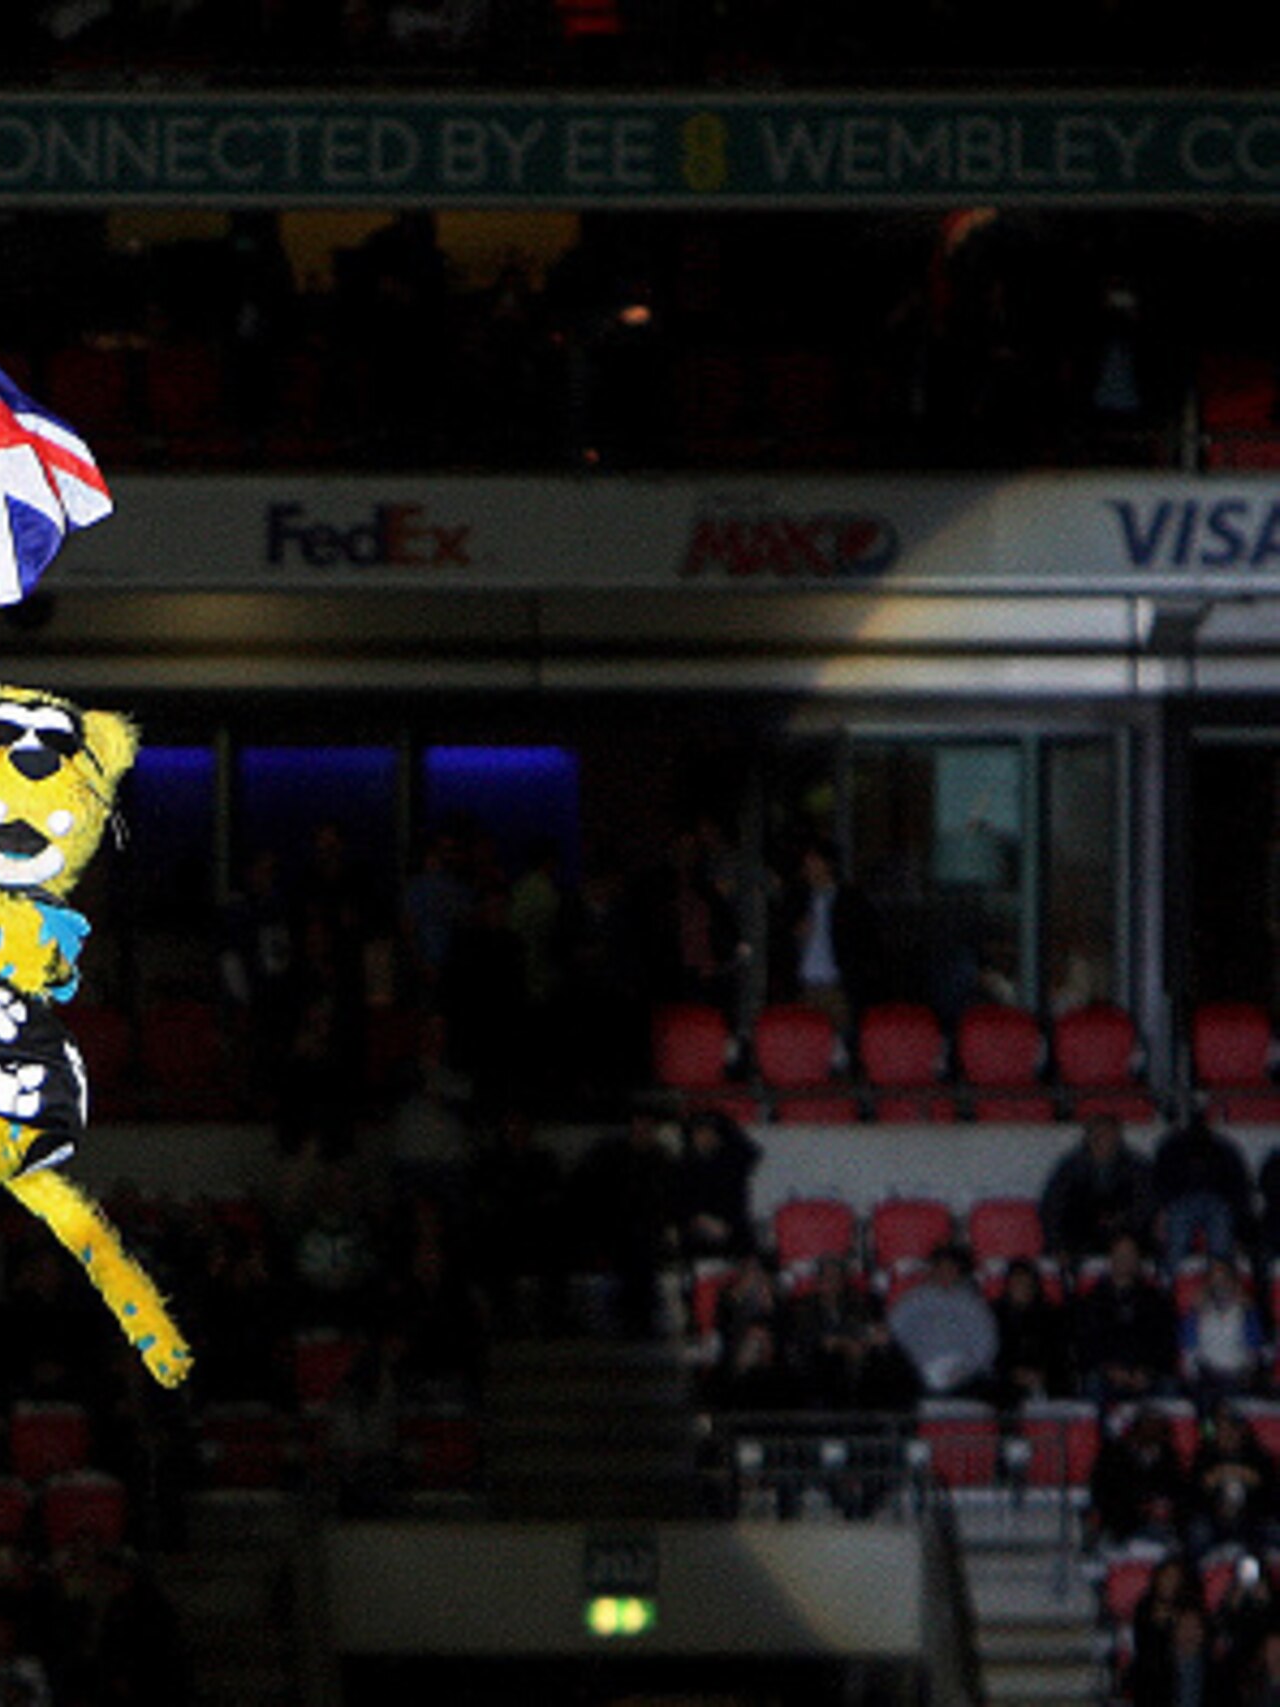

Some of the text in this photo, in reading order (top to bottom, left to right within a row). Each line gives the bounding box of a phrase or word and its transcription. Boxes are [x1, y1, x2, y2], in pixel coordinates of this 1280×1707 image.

[440, 116, 545, 183] BY
[563, 116, 656, 183] EE
[758, 115, 1153, 183] WEMBLEY
[266, 504, 471, 566] FedEx
